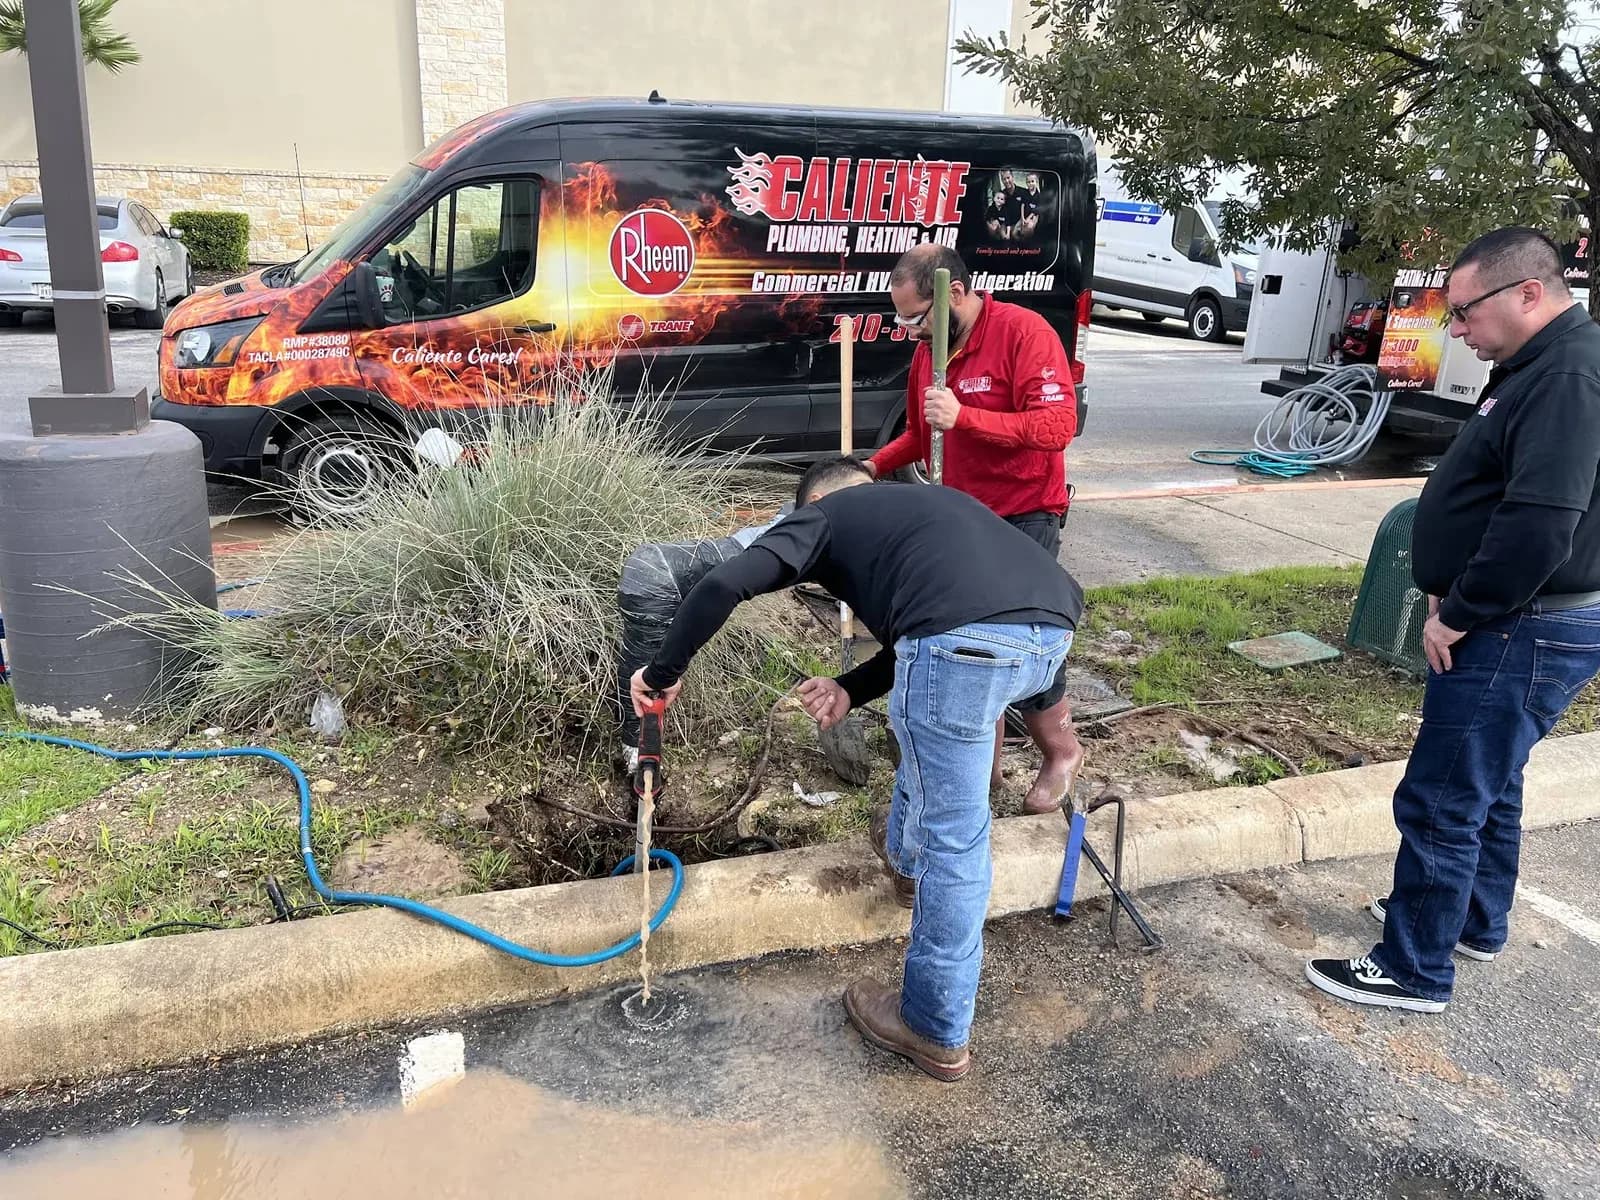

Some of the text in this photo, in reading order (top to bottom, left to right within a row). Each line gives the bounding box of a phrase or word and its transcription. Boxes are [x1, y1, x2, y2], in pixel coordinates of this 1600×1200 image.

[760, 154, 971, 226] CALIENTE
[619, 213, 689, 284] Rheem
[766, 224, 850, 258] PLUMBING,
[854, 226, 919, 254] HEATING
[933, 227, 959, 252] AIR
[751, 270, 860, 293] Commercial
[969, 270, 1055, 292] idgeration
[650, 320, 692, 333] TRANE
[1392, 315, 1437, 329] Specialists
[282, 334, 349, 349] RMP#38080
[391, 345, 523, 366] Caliente Cares!
